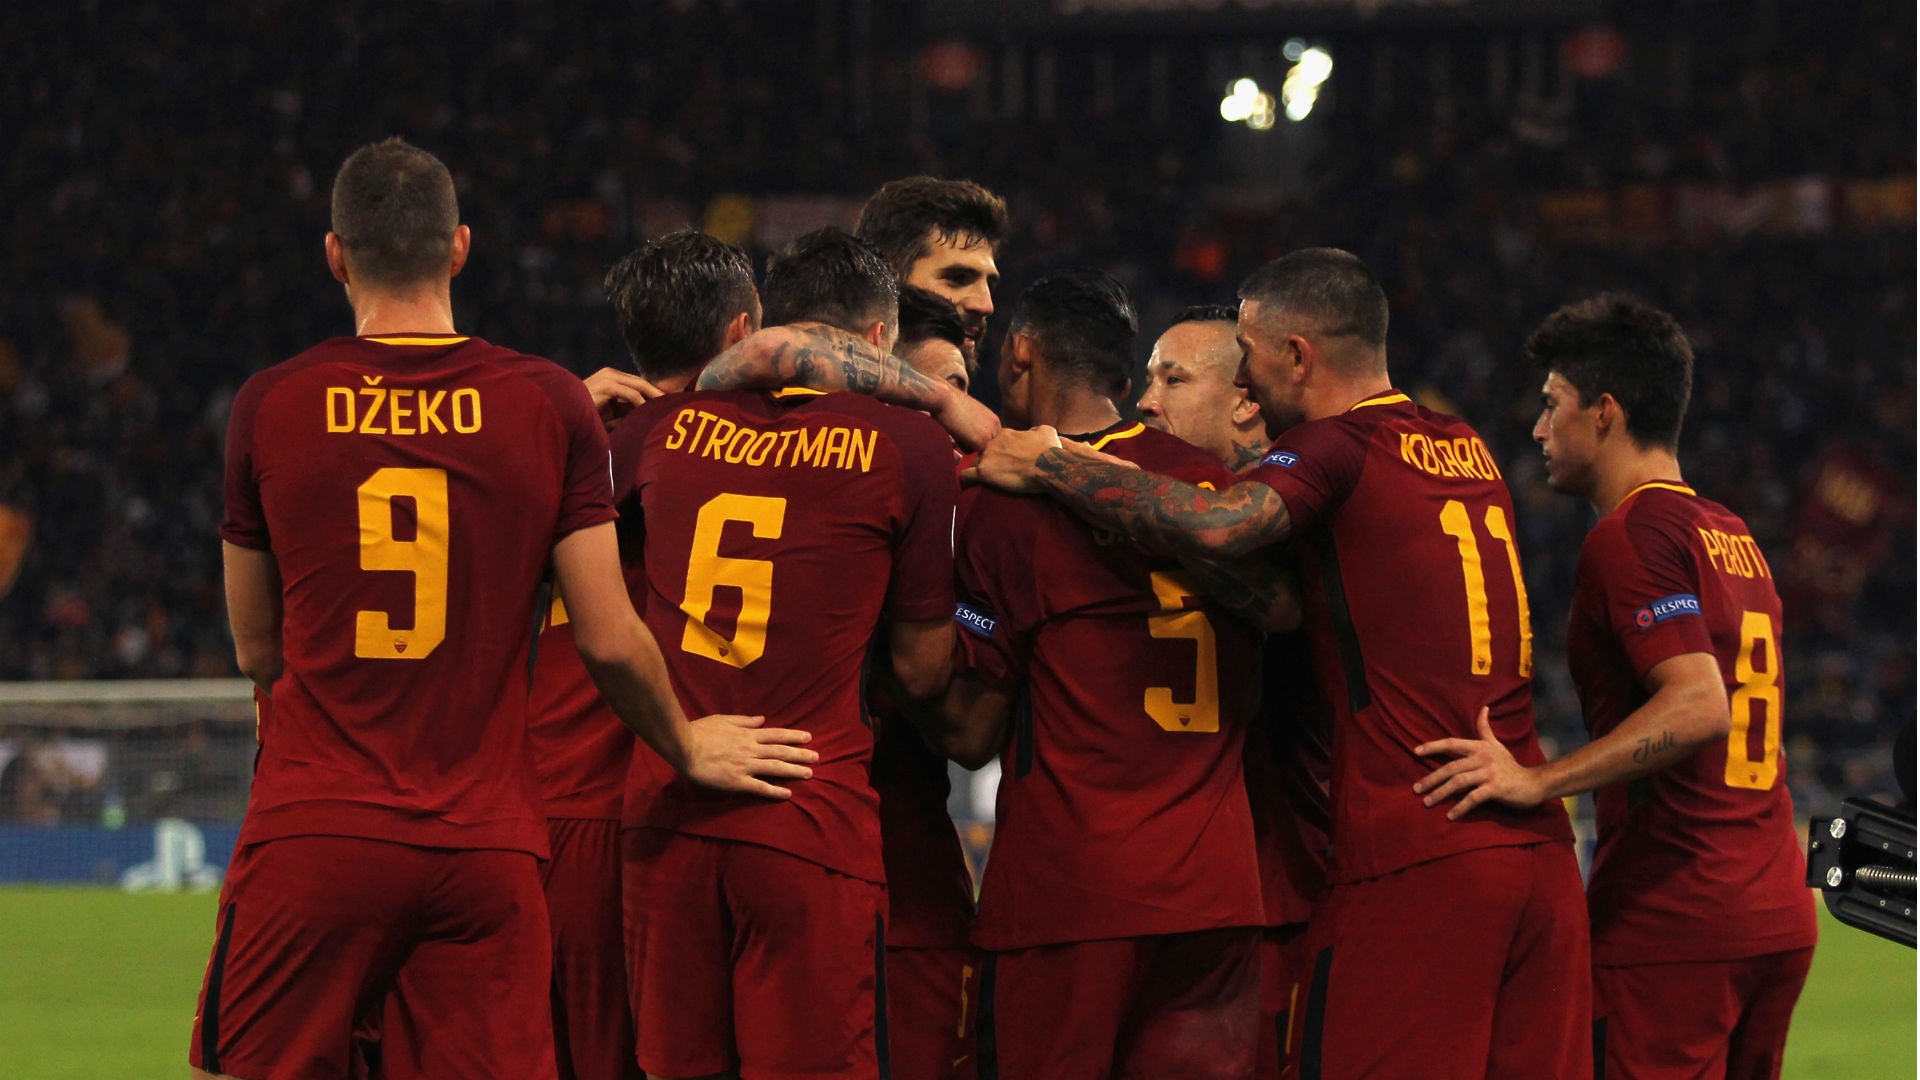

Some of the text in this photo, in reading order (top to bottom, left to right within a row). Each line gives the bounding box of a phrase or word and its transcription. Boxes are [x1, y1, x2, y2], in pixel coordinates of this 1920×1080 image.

[326, 375, 482, 435] DŽEKO
[666, 408, 879, 473] STROOTMAN
[355, 467, 449, 660] 9
[680, 493, 787, 669] 6
[1439, 499, 1533, 679] 11
[1652, 599, 1699, 617] RESPECT
[1144, 571, 1219, 733] 5
[1724, 610, 1780, 791] 8
